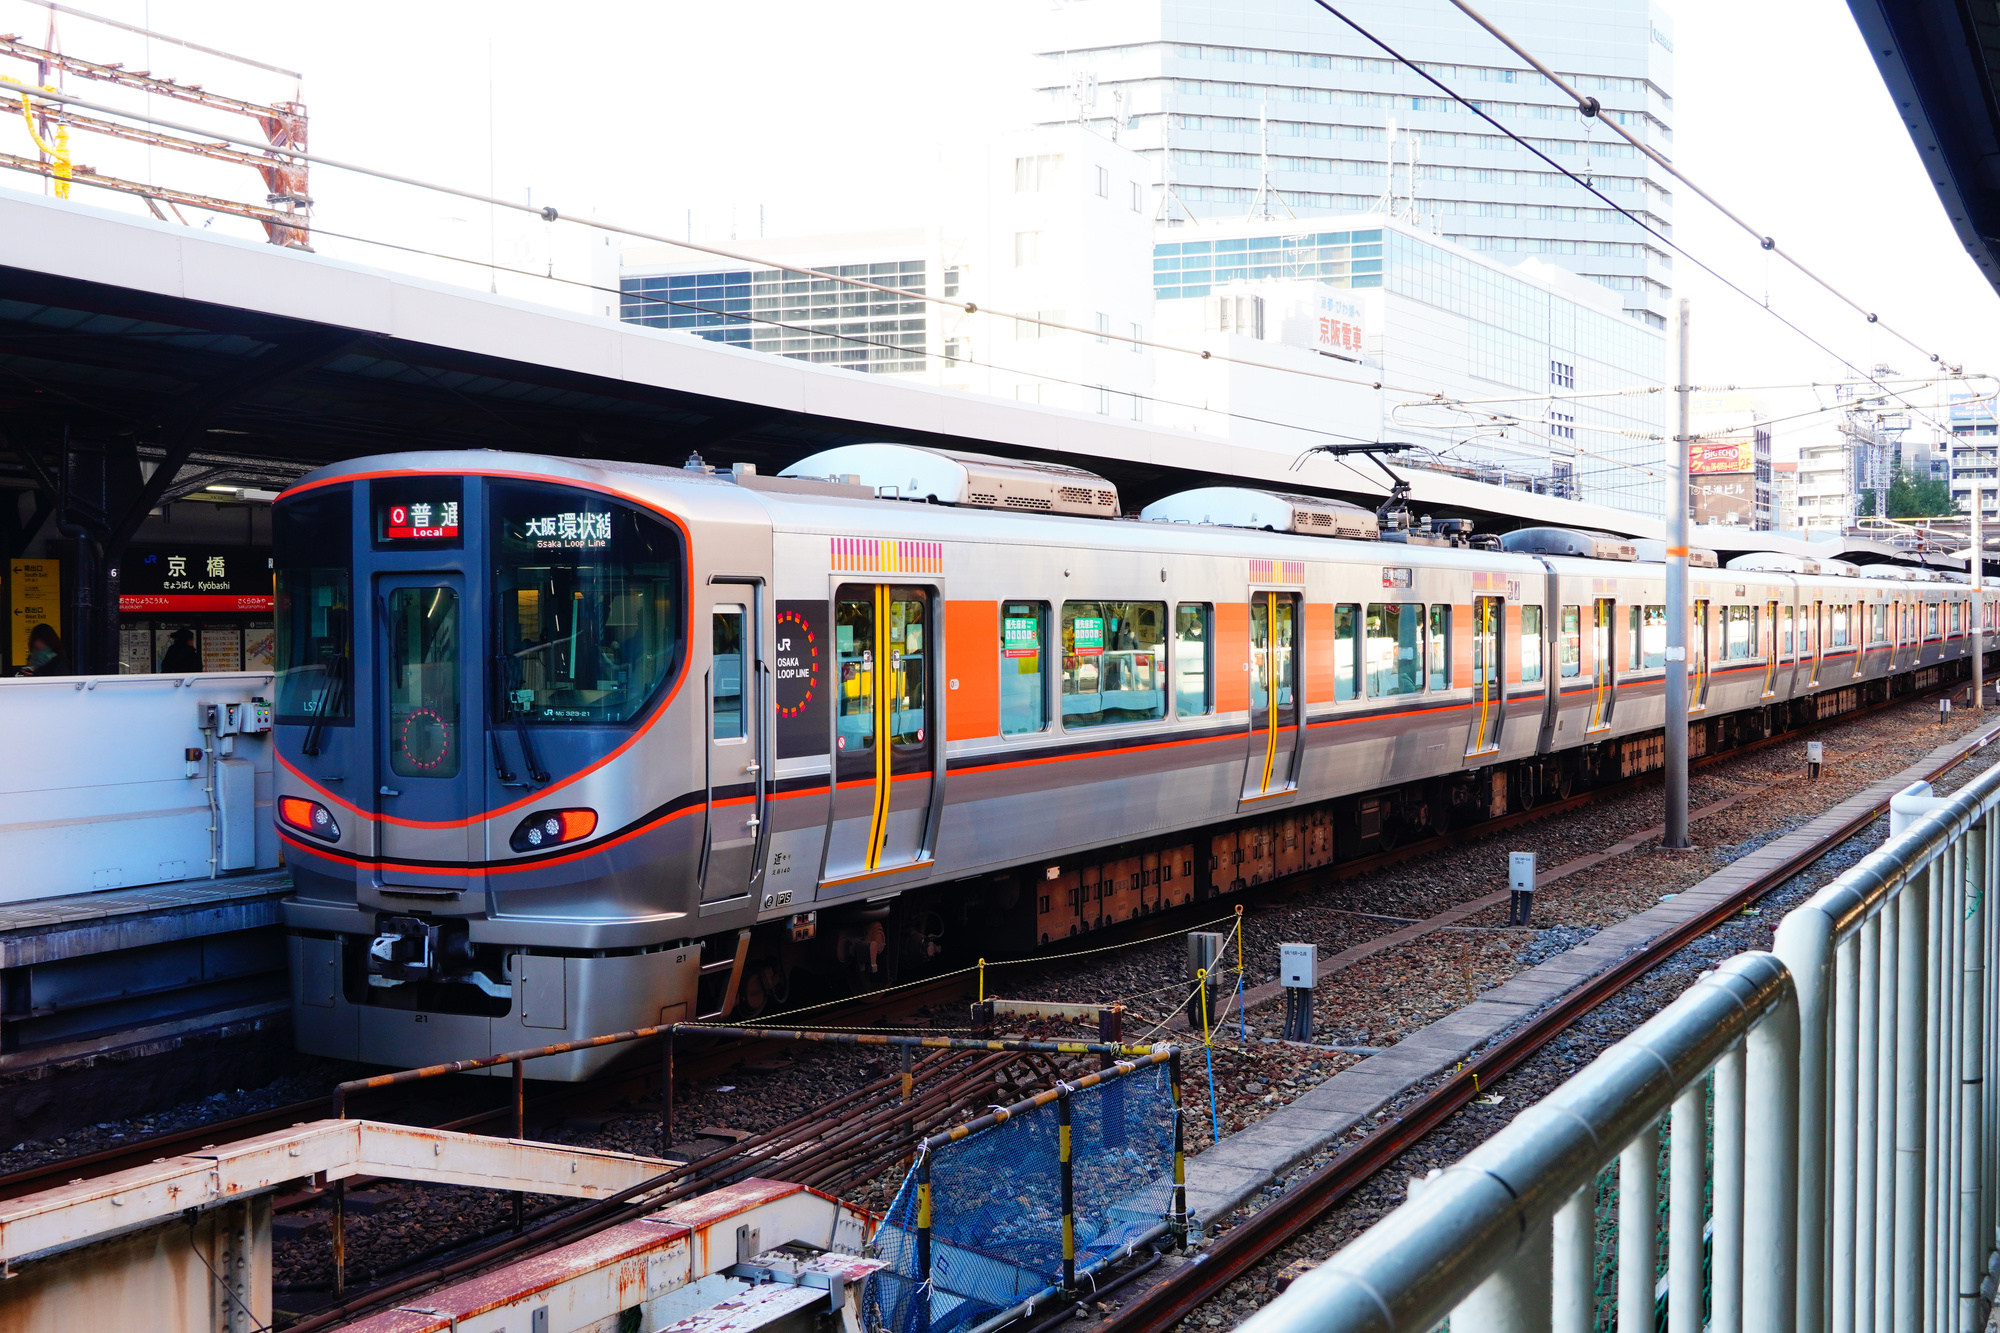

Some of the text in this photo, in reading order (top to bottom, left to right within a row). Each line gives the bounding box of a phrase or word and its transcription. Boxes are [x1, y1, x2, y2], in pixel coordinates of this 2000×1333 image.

[1319, 316, 1362, 352] 京阪電車
[1703, 449, 1718, 459] BIG
[1718, 449, 1738, 458] ECHO
[1740, 458, 1750, 470] 2F
[410, 501, 458, 527] 普通
[525, 511, 611, 540] 大阪環状線
[413, 528, 443, 537] Local
[564, 540, 585, 548] Loop
[588, 539, 606, 547] Line
[144, 555, 157, 564] JR
[167, 555, 226, 578] 京橋
[111, 568, 117, 577] 6
[163, 581, 230, 591] きょうばし Kyōbashi
[777, 638, 791, 651] JR
[777, 657, 799, 667] OSAKA
[777, 668, 810, 679] LOOP LINE
[543, 708, 553, 716] JR
[676, 954, 686, 963] 21
[415, 1014, 428, 1023] 21
